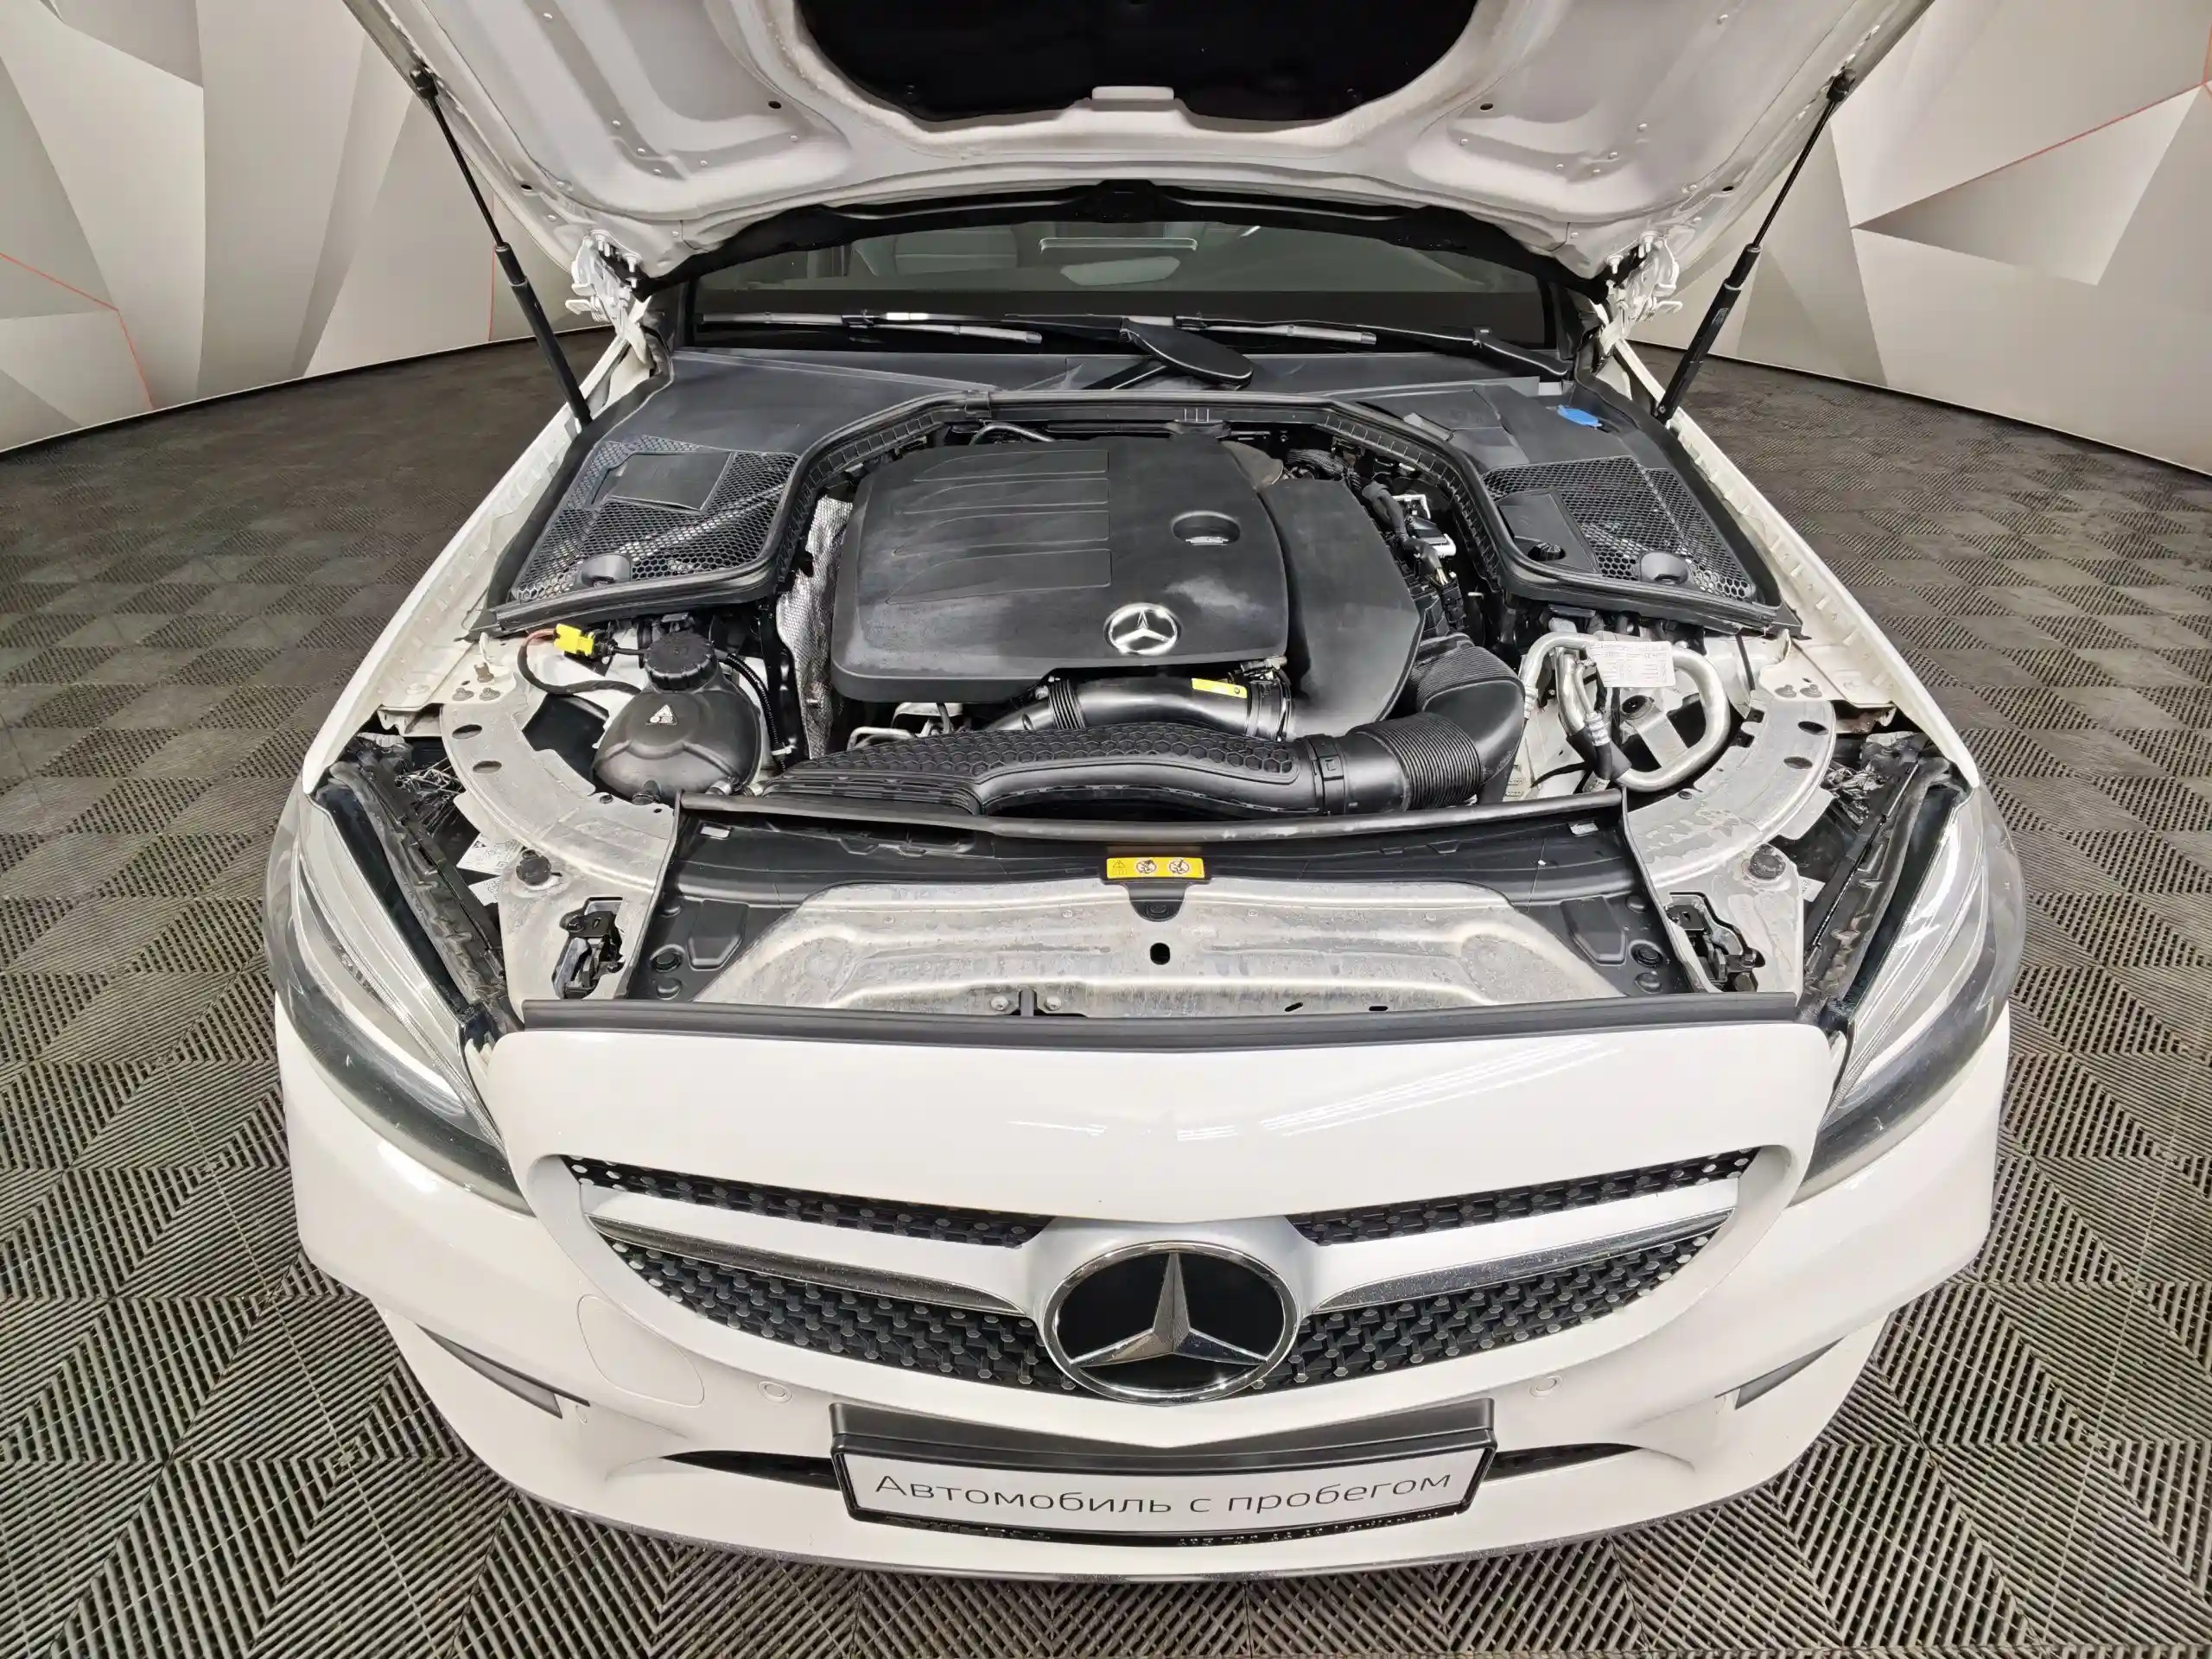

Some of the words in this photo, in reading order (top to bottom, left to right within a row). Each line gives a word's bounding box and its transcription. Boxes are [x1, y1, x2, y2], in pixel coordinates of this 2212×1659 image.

[875, 1475, 1172, 1513] Автомобиль
[1190, 1498, 1211, 1512] с
[1228, 1472, 1451, 1513] пробегом
